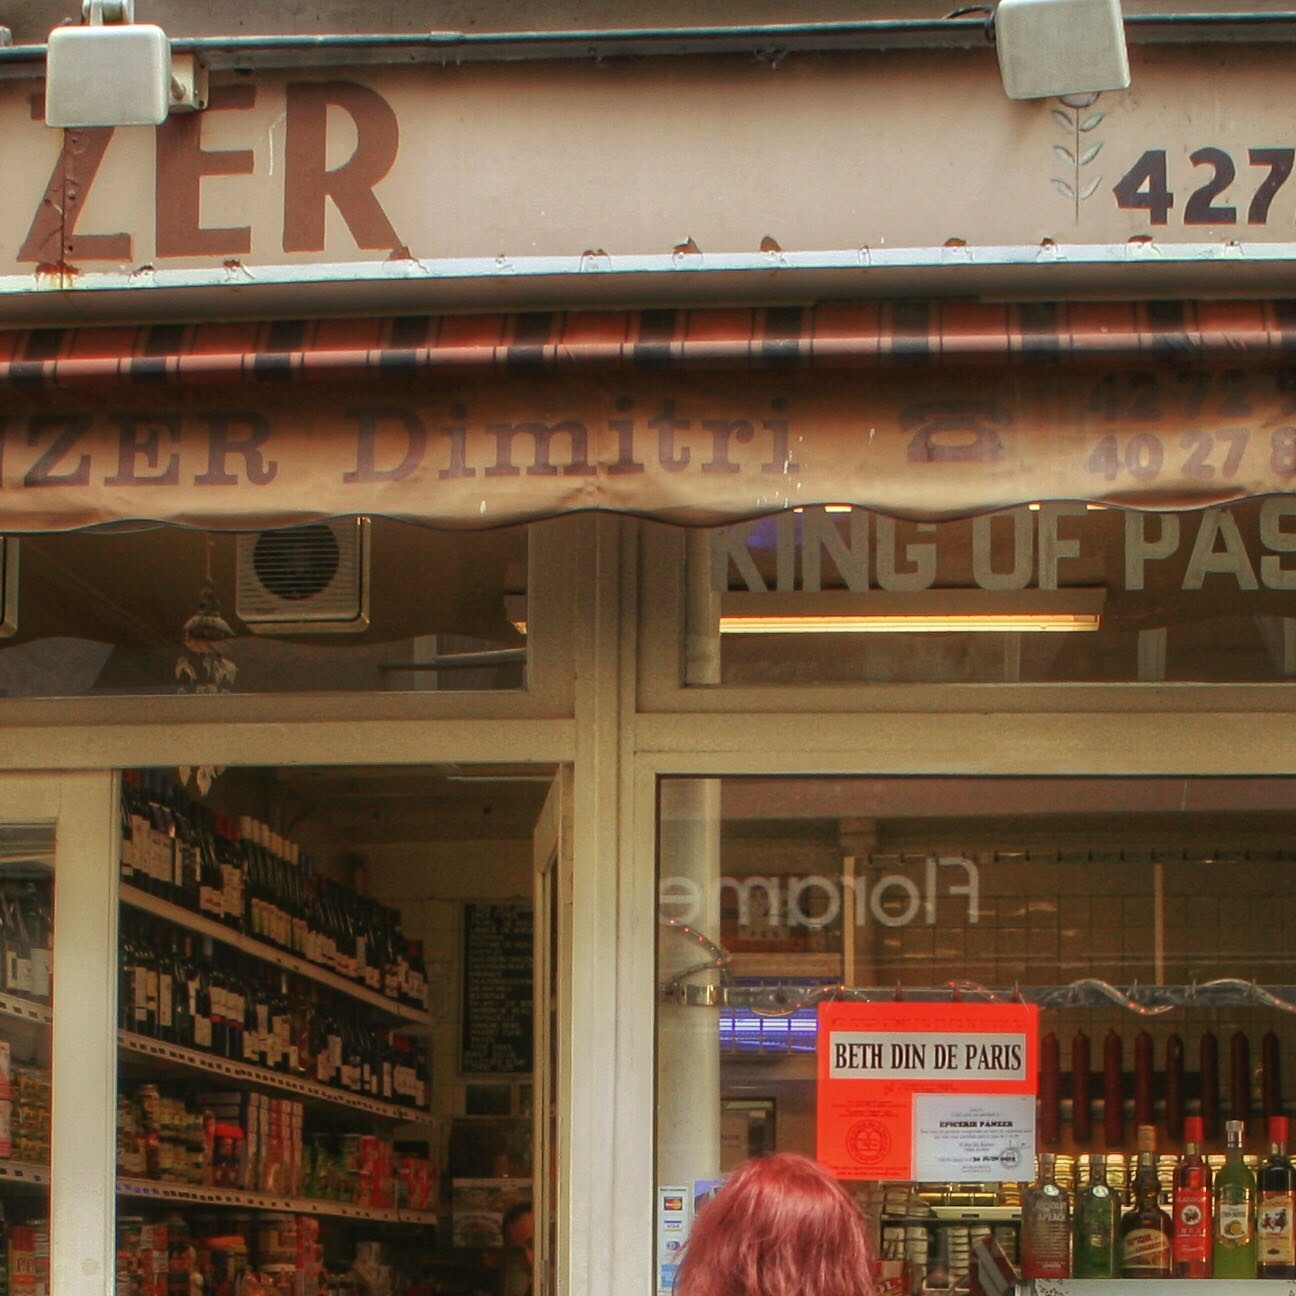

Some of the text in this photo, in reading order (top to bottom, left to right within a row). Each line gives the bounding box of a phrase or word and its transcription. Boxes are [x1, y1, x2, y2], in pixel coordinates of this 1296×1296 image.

[343, 397, 799, 484] Dimitri
[1085, 432, 1164, 482] 40
[1179, 427, 1250, 480] 27
[711, 506, 939, 592] KING
[973, 505, 1088, 592] OF
[835, 1042, 1022, 1071] BETH DIN DE PARIS
